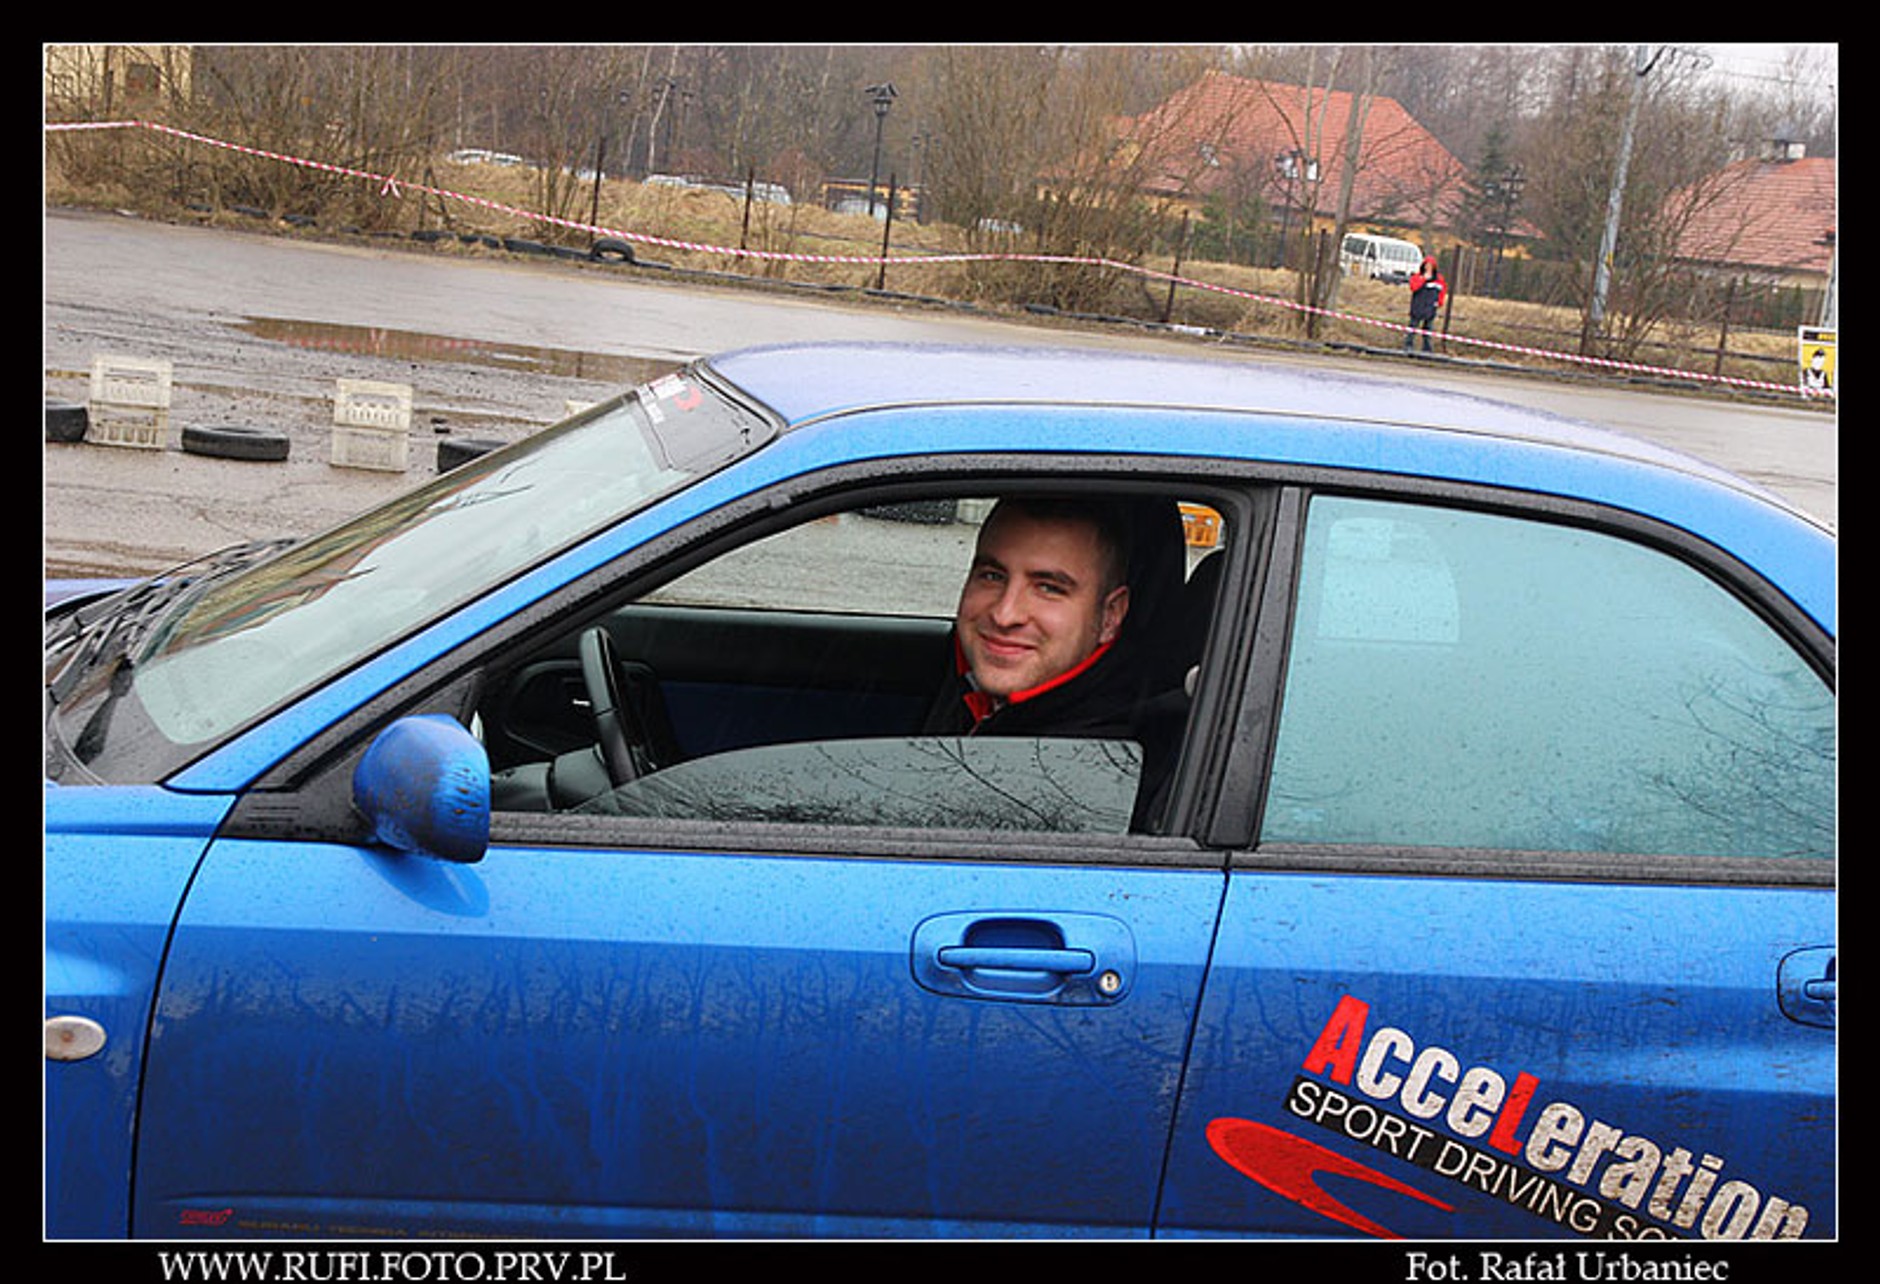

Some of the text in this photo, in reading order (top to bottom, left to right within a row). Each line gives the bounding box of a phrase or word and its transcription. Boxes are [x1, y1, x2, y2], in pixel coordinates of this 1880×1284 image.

[1289, 1081, 1601, 1232] SPORT DRIVING
[1302, 994, 1809, 1239] AcceLeration
